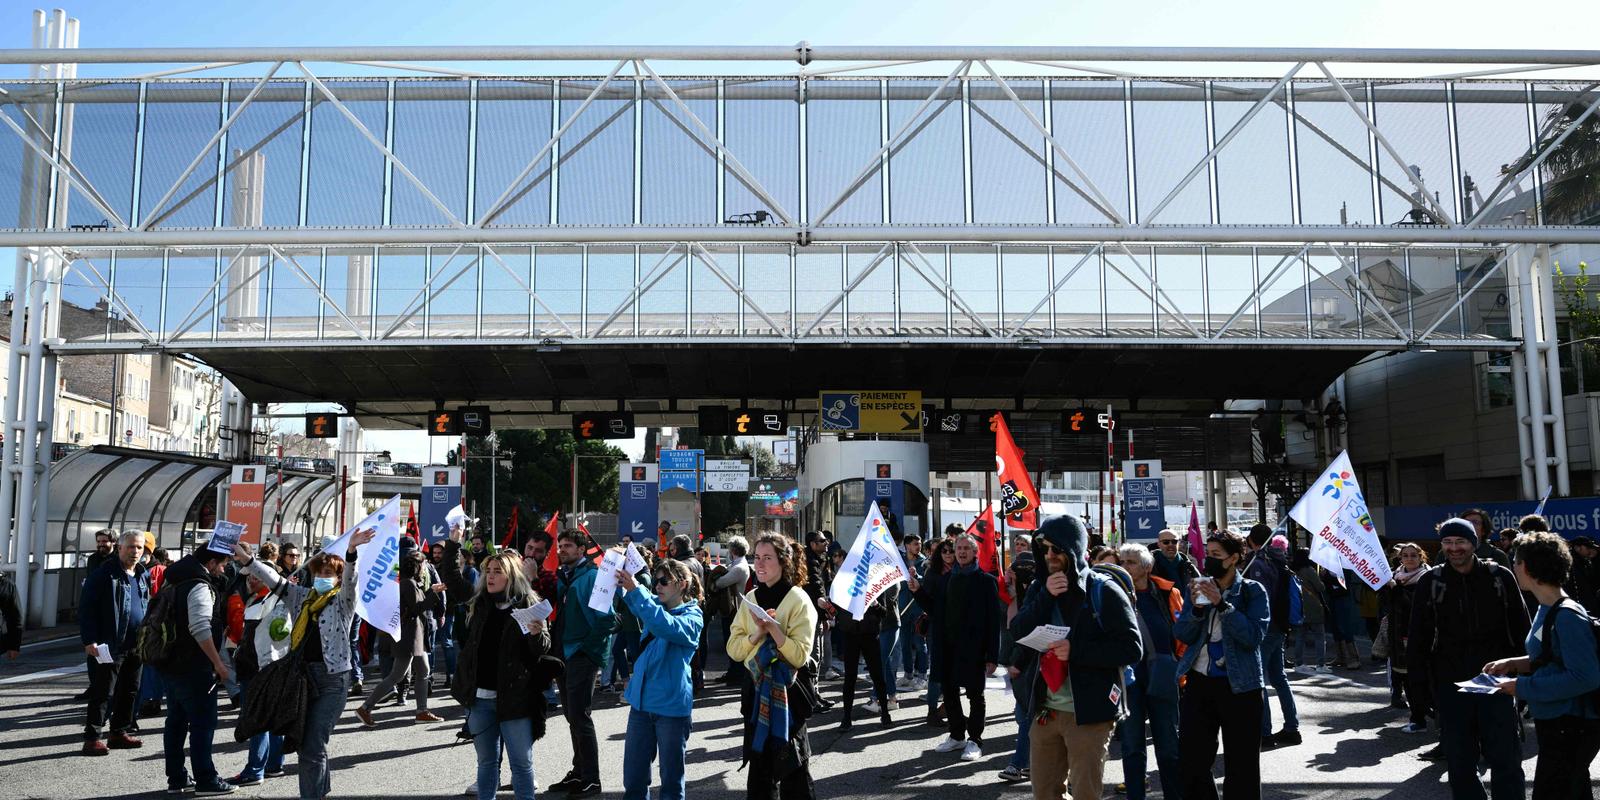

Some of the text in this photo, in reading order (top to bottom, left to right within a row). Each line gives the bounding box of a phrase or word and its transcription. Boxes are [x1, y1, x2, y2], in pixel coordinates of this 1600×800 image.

[860, 392, 907, 400] PAIEMENT
[860, 400, 915, 410] EN ESPÈCES
[231, 500, 262, 508] Télépéage
[1345, 498, 1372, 529] FSU
[1549, 513, 1588, 531] vous
[1319, 525, 1381, 585] Bouches-du-Rhône
